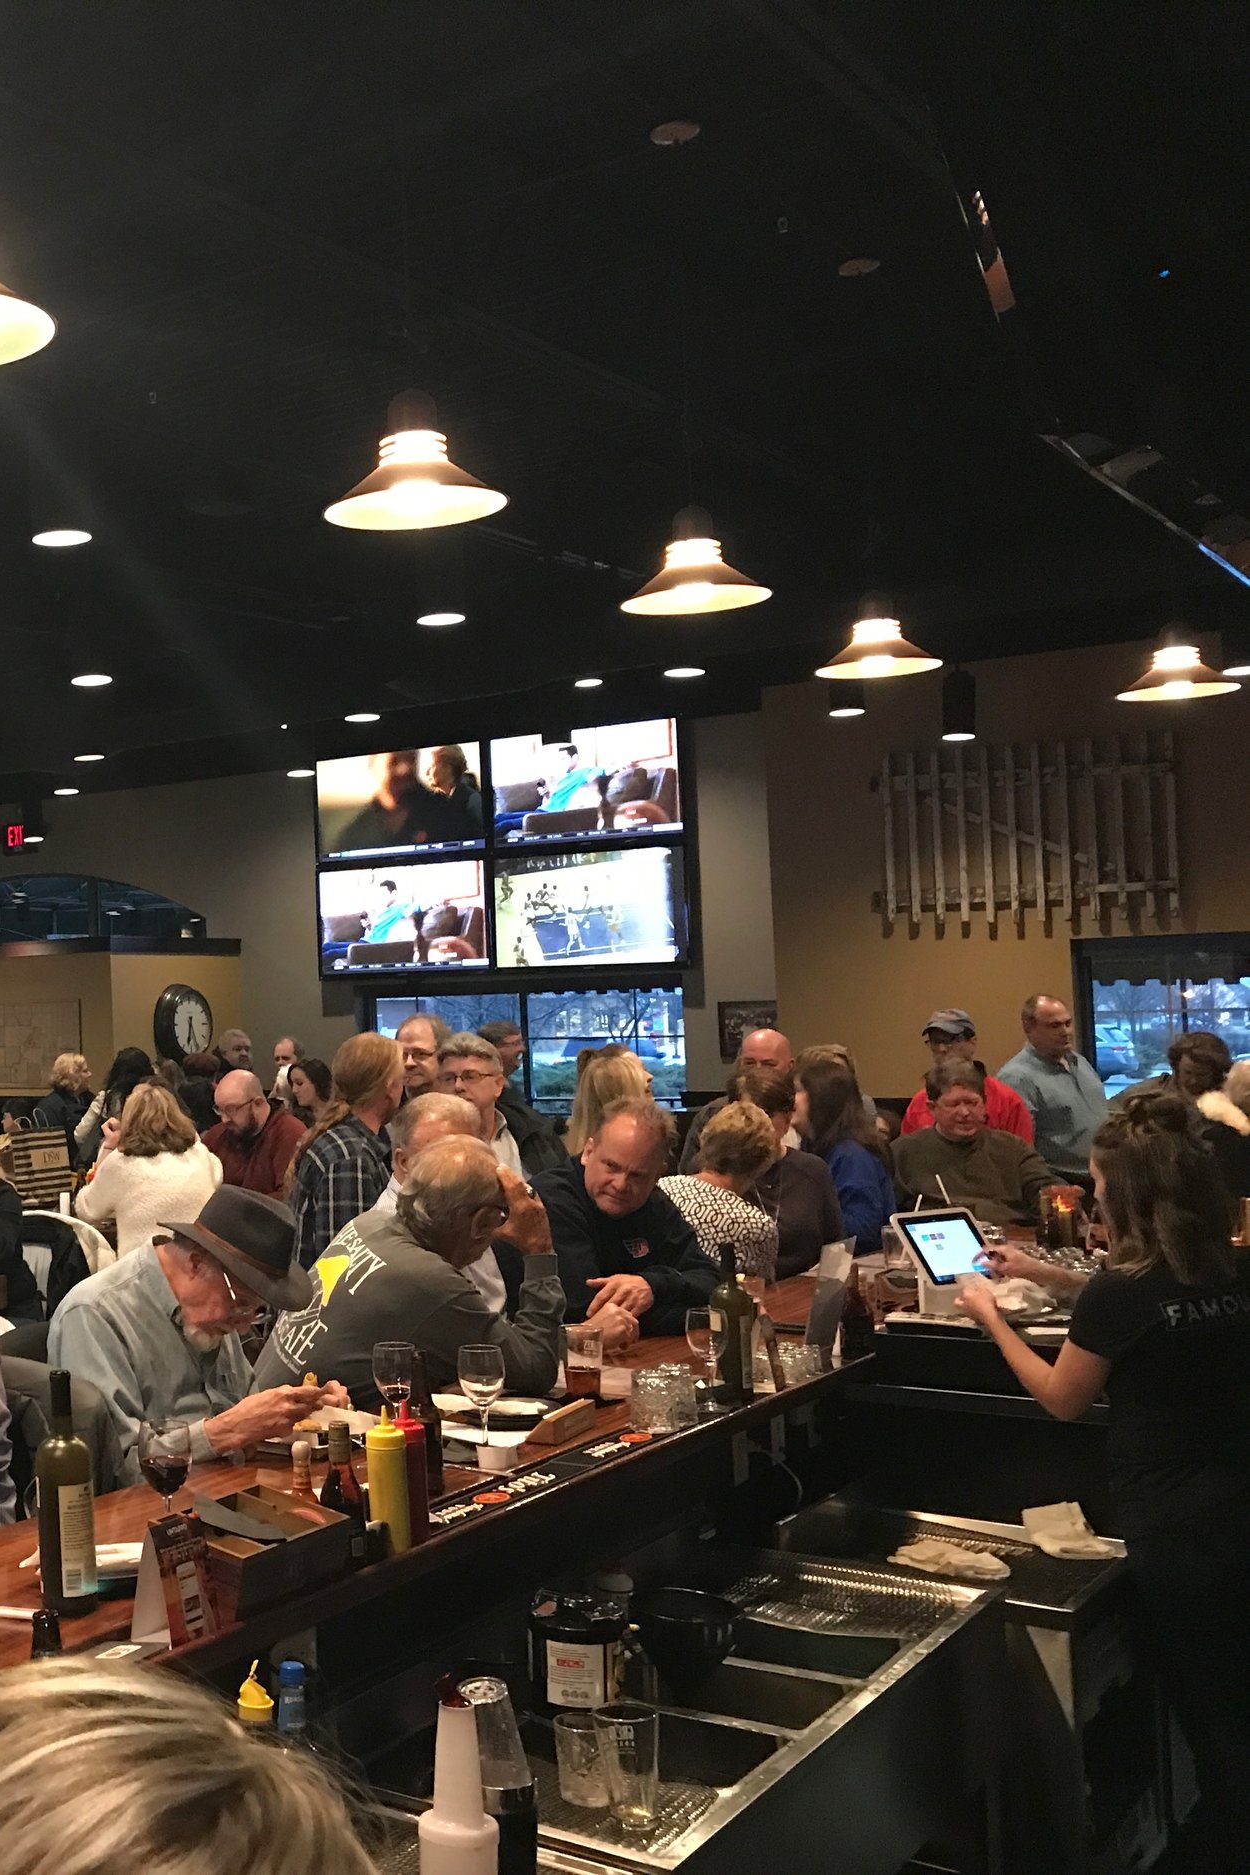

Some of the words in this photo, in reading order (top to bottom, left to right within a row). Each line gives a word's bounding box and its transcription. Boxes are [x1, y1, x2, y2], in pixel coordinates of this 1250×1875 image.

[7, 825, 24, 847] EXI
[43, 1151, 60, 1164] DSW
[344, 1237, 387, 1296] SALTY
